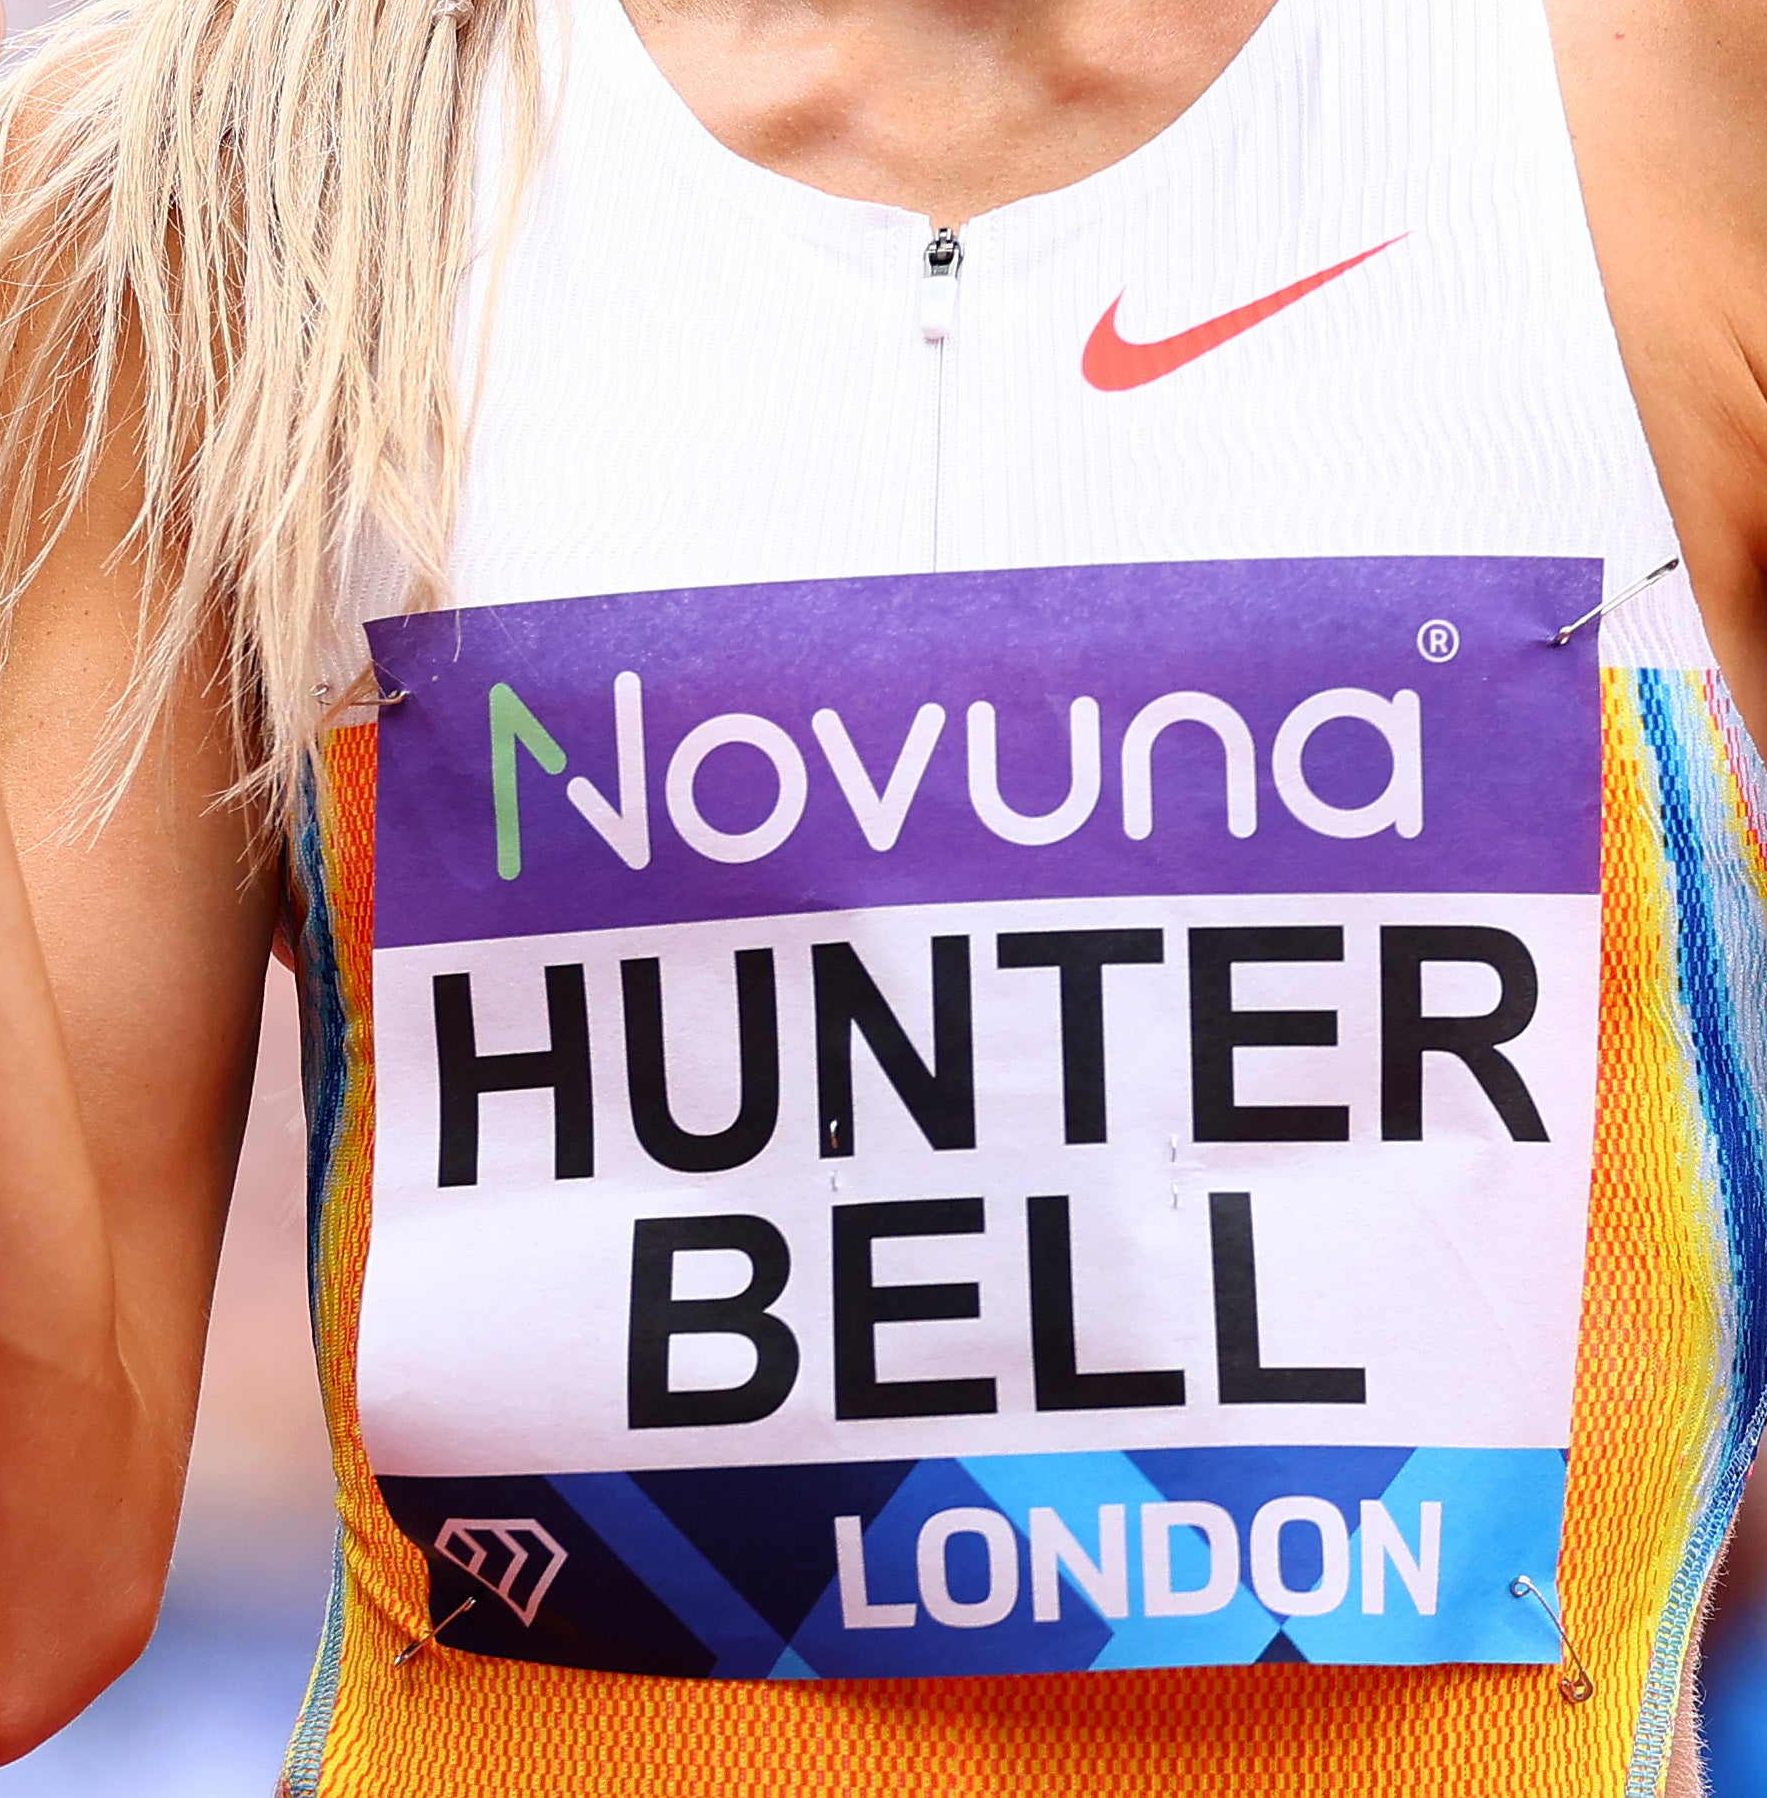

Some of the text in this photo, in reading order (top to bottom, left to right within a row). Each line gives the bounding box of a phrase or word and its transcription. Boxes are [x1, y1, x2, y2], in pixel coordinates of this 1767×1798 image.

[489, 670, 1423, 880] Novuna
[431, 924, 1551, 1187] HUNTER
[627, 1190, 1368, 1430] BELL
[834, 1496, 1442, 1631] LONDON
